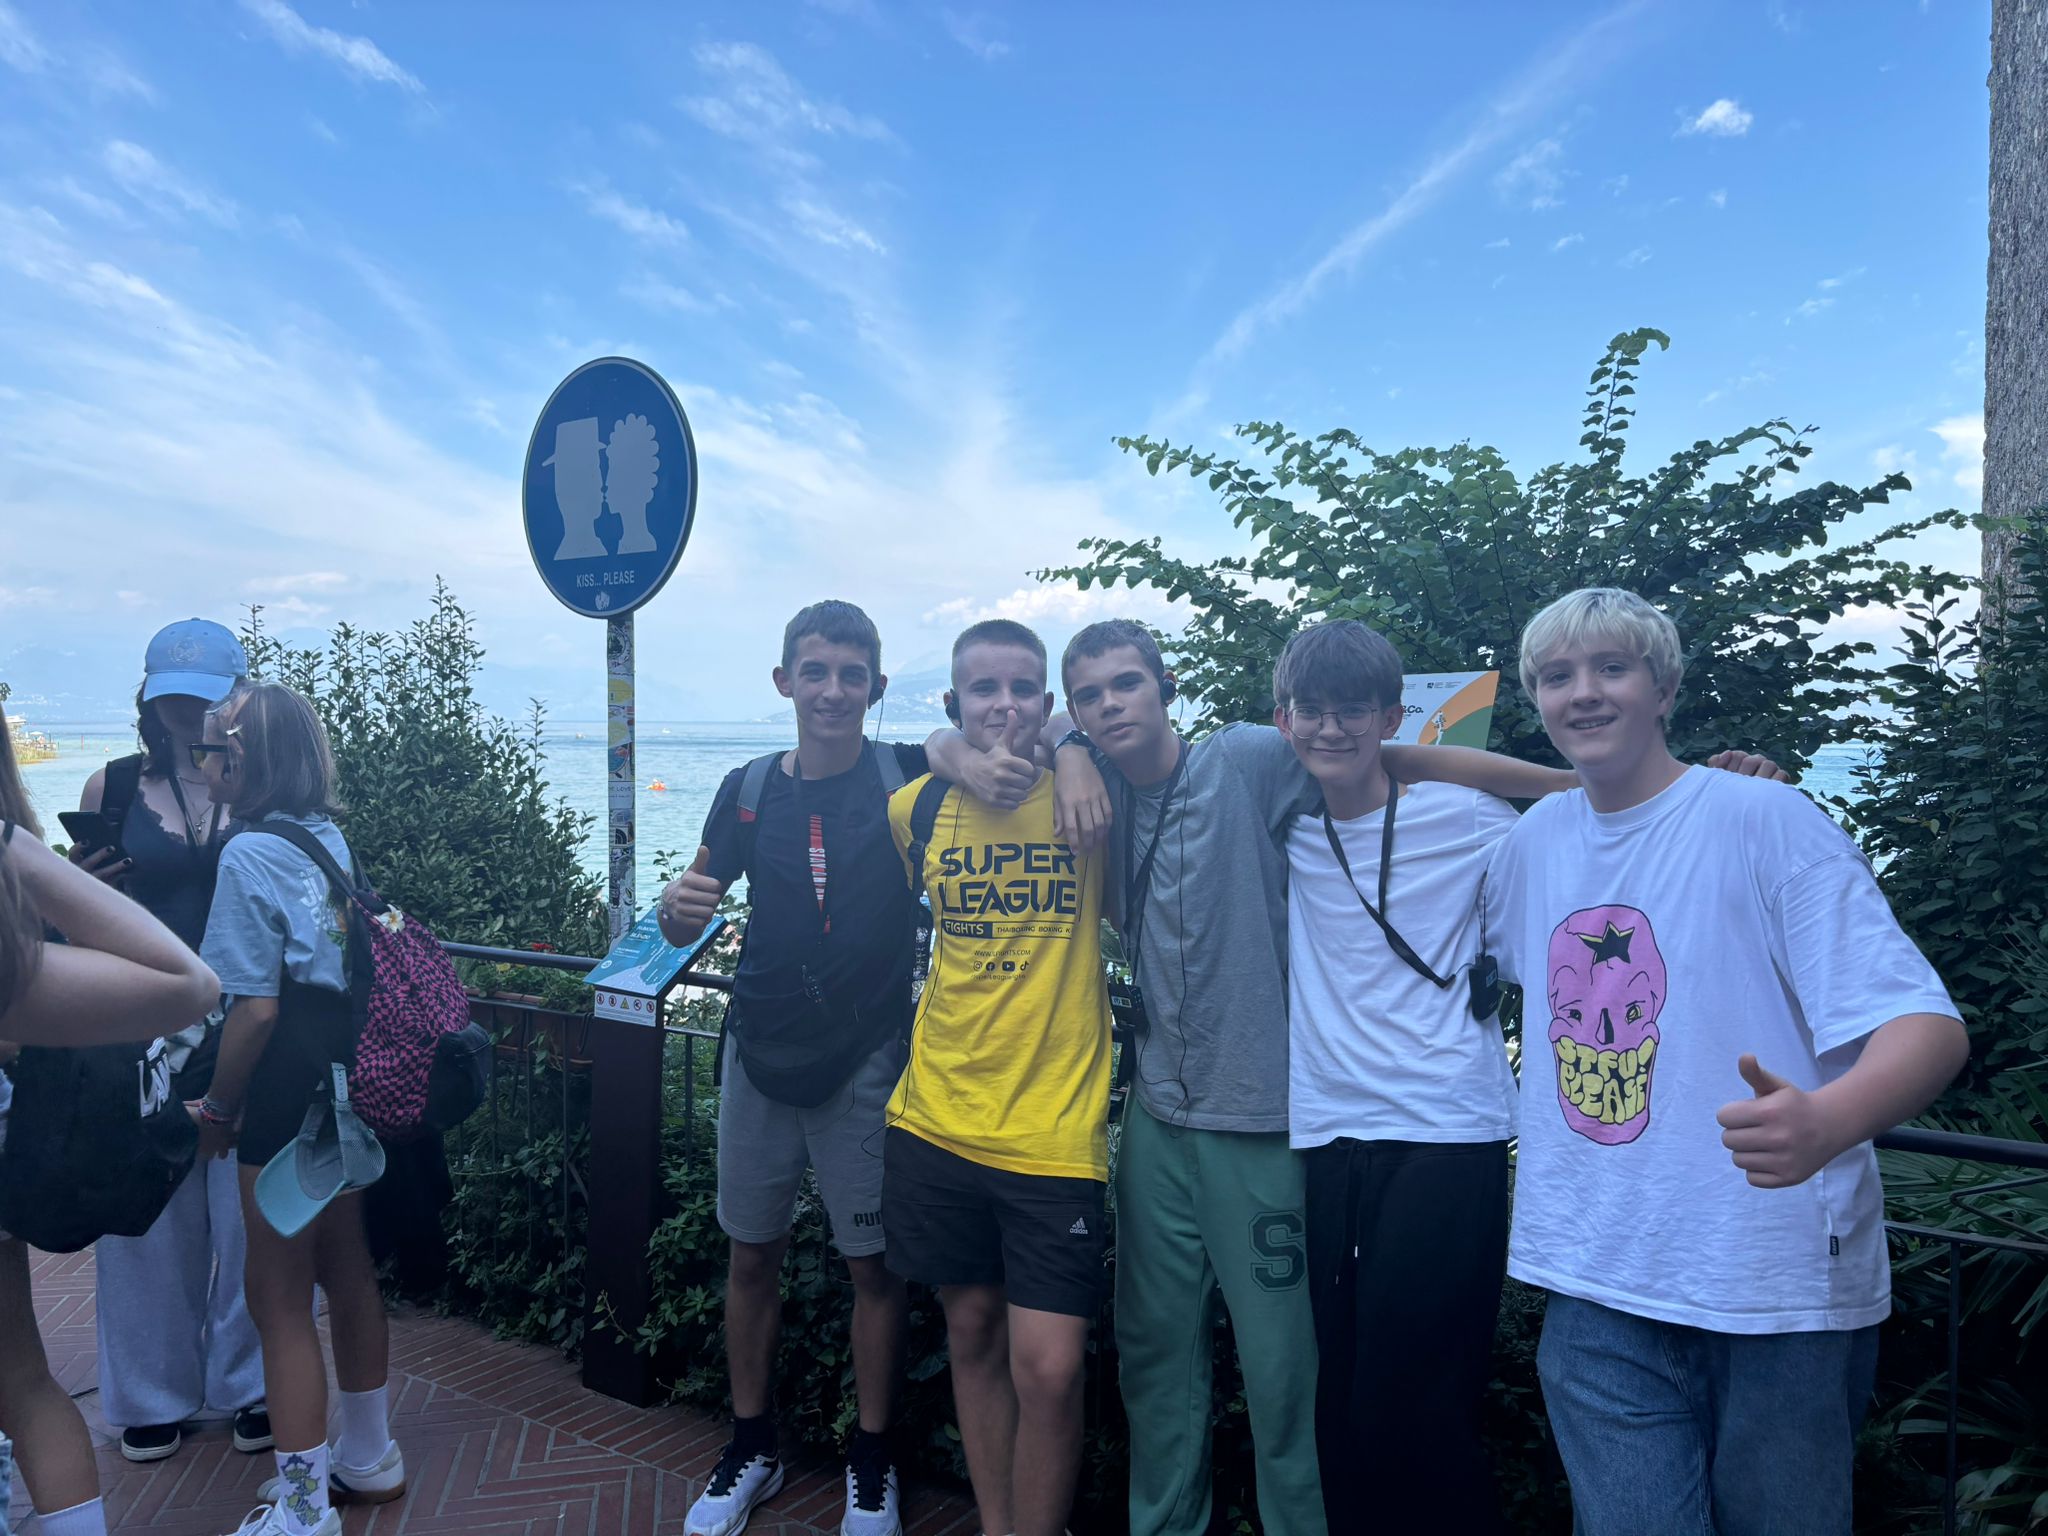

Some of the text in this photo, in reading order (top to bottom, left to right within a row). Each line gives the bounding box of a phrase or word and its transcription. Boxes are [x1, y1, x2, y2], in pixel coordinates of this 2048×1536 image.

[576, 570, 635, 588] KISS... PLEASE
[939, 842, 1076, 877] SUPER
[938, 879, 1077, 917] LEAGUE
[944, 920, 984, 935] FIGHTS
[1038, 925, 1063, 934] BOXING
[1559, 1061, 1649, 1125] PLEASE
[1248, 1210, 1307, 1292] S
